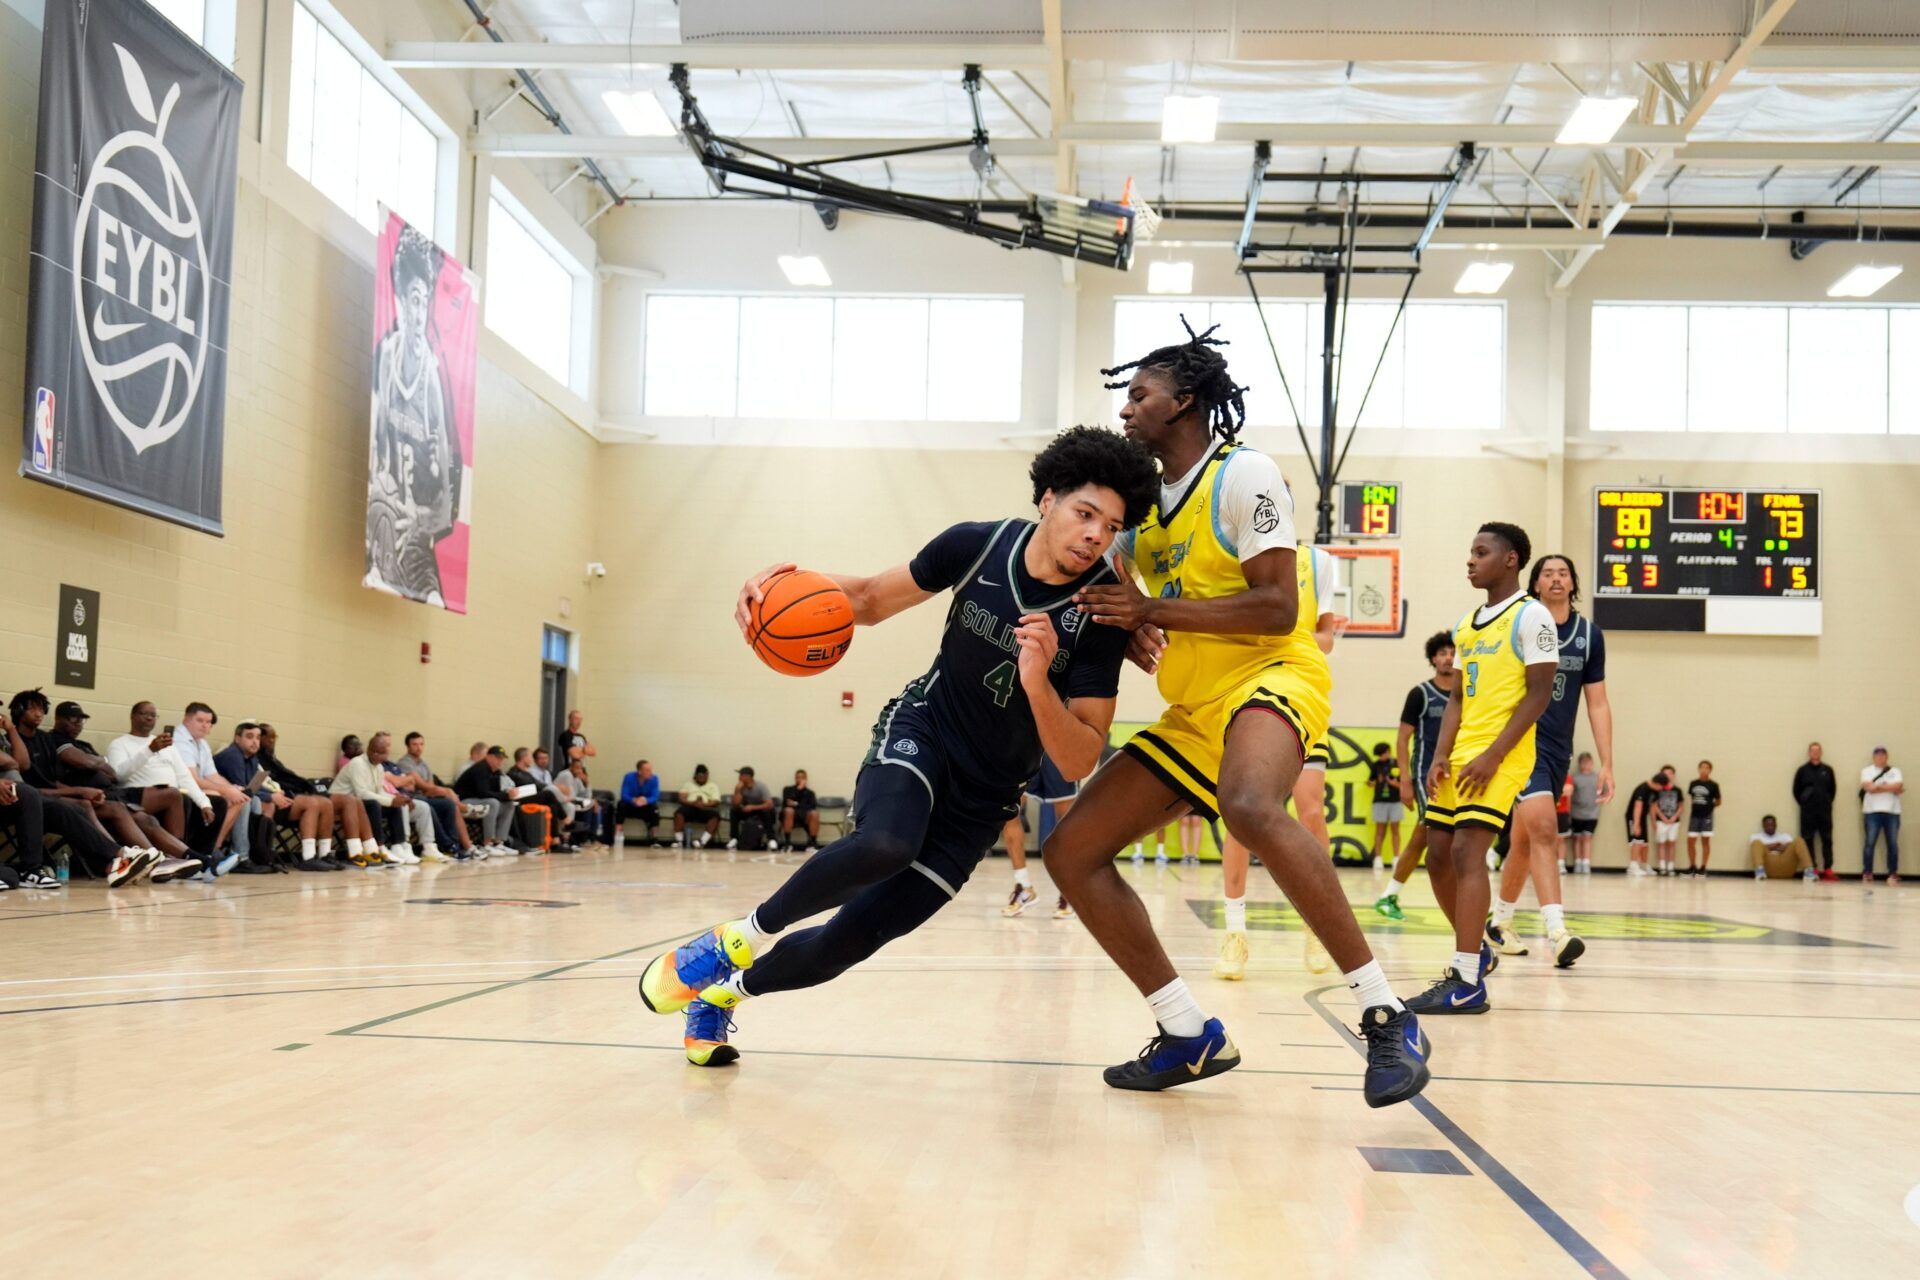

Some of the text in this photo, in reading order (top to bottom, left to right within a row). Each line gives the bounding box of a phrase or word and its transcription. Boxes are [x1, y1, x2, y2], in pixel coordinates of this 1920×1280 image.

[97, 208, 196, 336] EYBL
[1363, 486, 1396, 505] 1:04
[1699, 493, 1743, 520] 1:04
[1763, 494, 1805, 508] FINAL
[1363, 504, 1390, 533] 19
[1617, 508, 1651, 536] 80
[1770, 510, 1803, 538] 73
[1670, 532, 1713, 543] PERIOD
[1718, 528, 1733, 550] 4
[1603, 554, 1632, 563] FOULS
[1677, 556, 1738, 565] PLAYER-FOUL
[1783, 557, 1812, 566] FOULS
[1612, 564, 1628, 586] 5
[1642, 564, 1658, 587] 3
[1764, 566, 1772, 588] 1
[1792, 566, 1807, 589] 5
[1677, 587, 1711, 595] MATCH
[961, 600, 1070, 673] SOLDIS
[806, 638, 852, 662] ELITE
[983, 660, 1017, 708] 4
[1467, 662, 1478, 697] 3
[1324, 782, 1366, 825] BL
